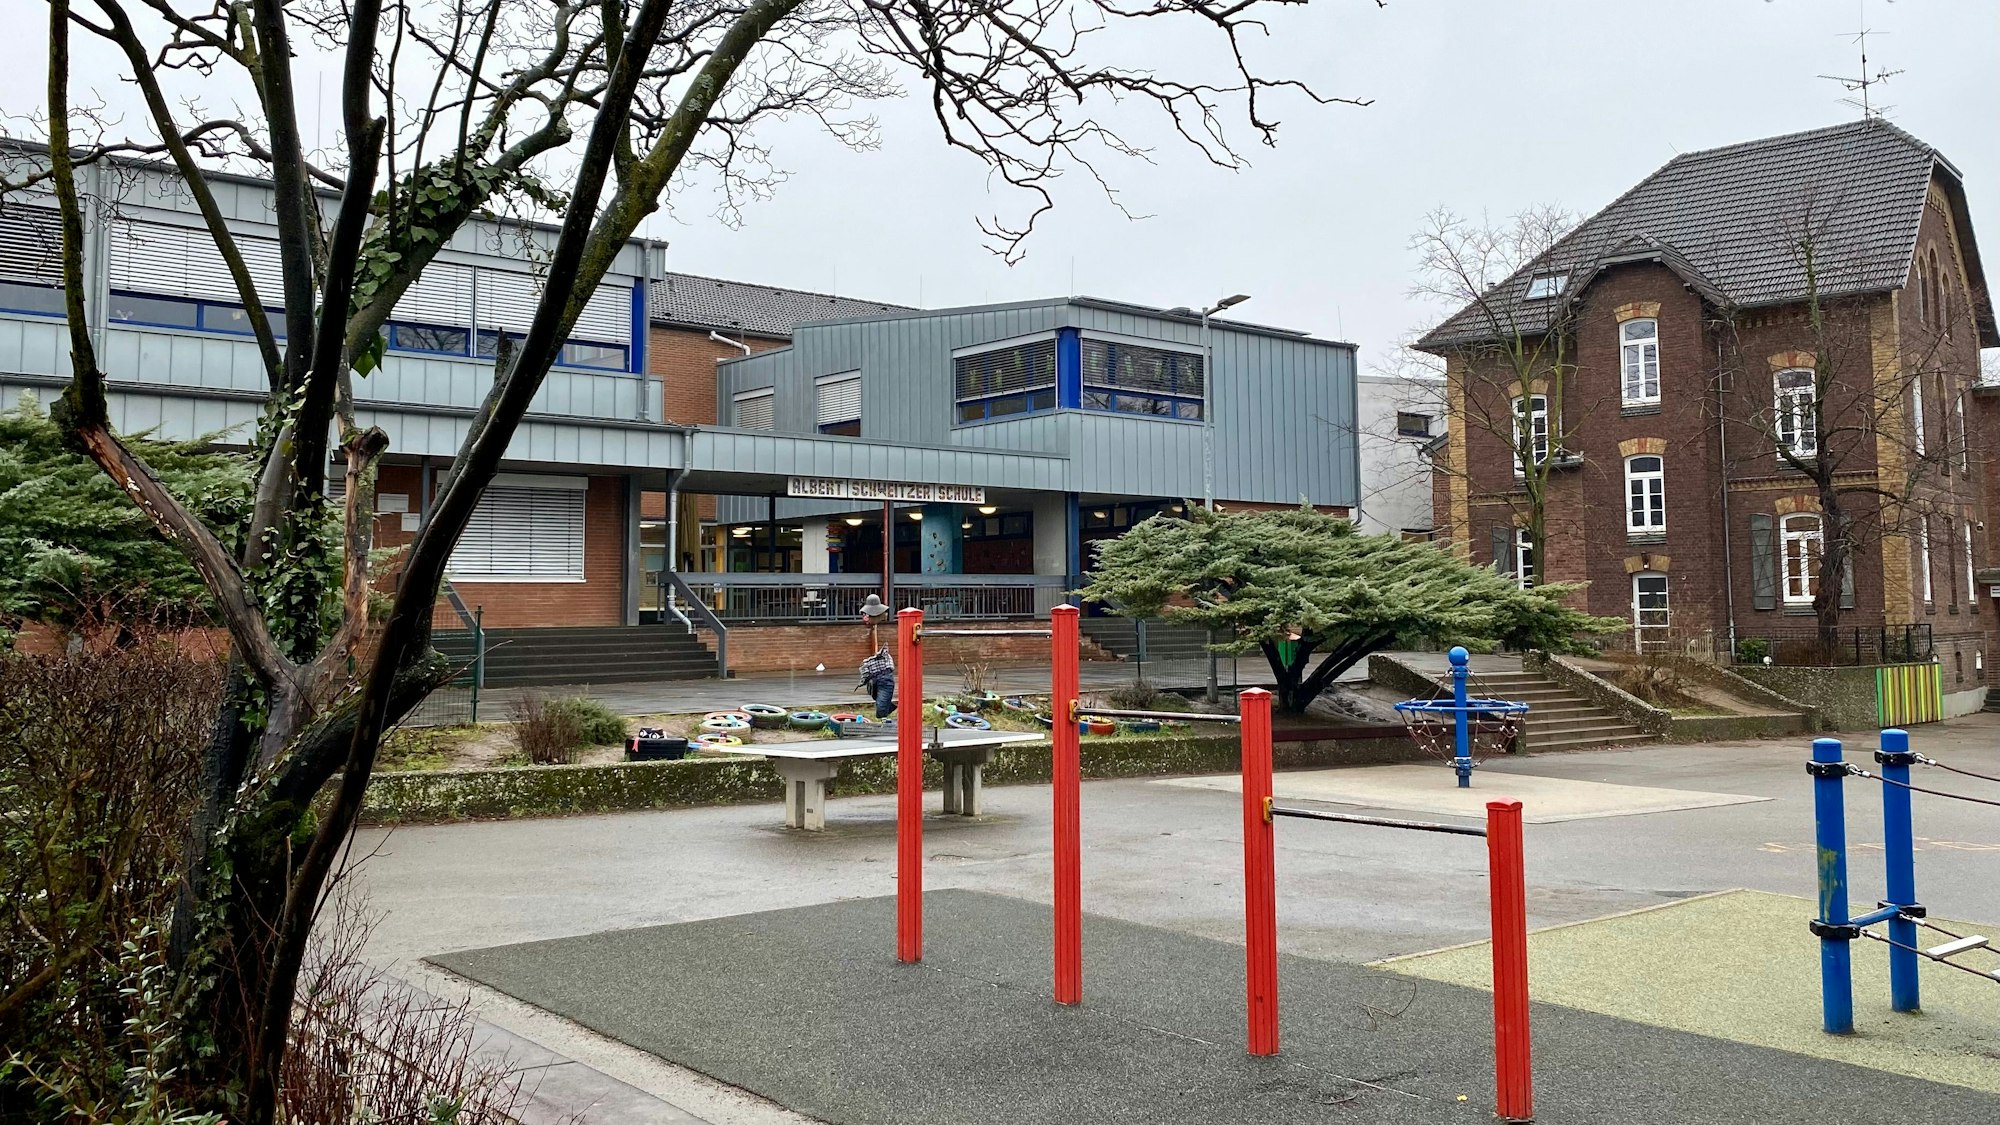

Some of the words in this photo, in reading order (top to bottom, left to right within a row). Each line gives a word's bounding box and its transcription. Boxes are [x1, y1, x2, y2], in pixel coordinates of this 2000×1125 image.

[792, 478, 844, 496] ALBERT
[851, 480, 931, 500] SCHWEITZER
[938, 485, 982, 502] SCHULE
